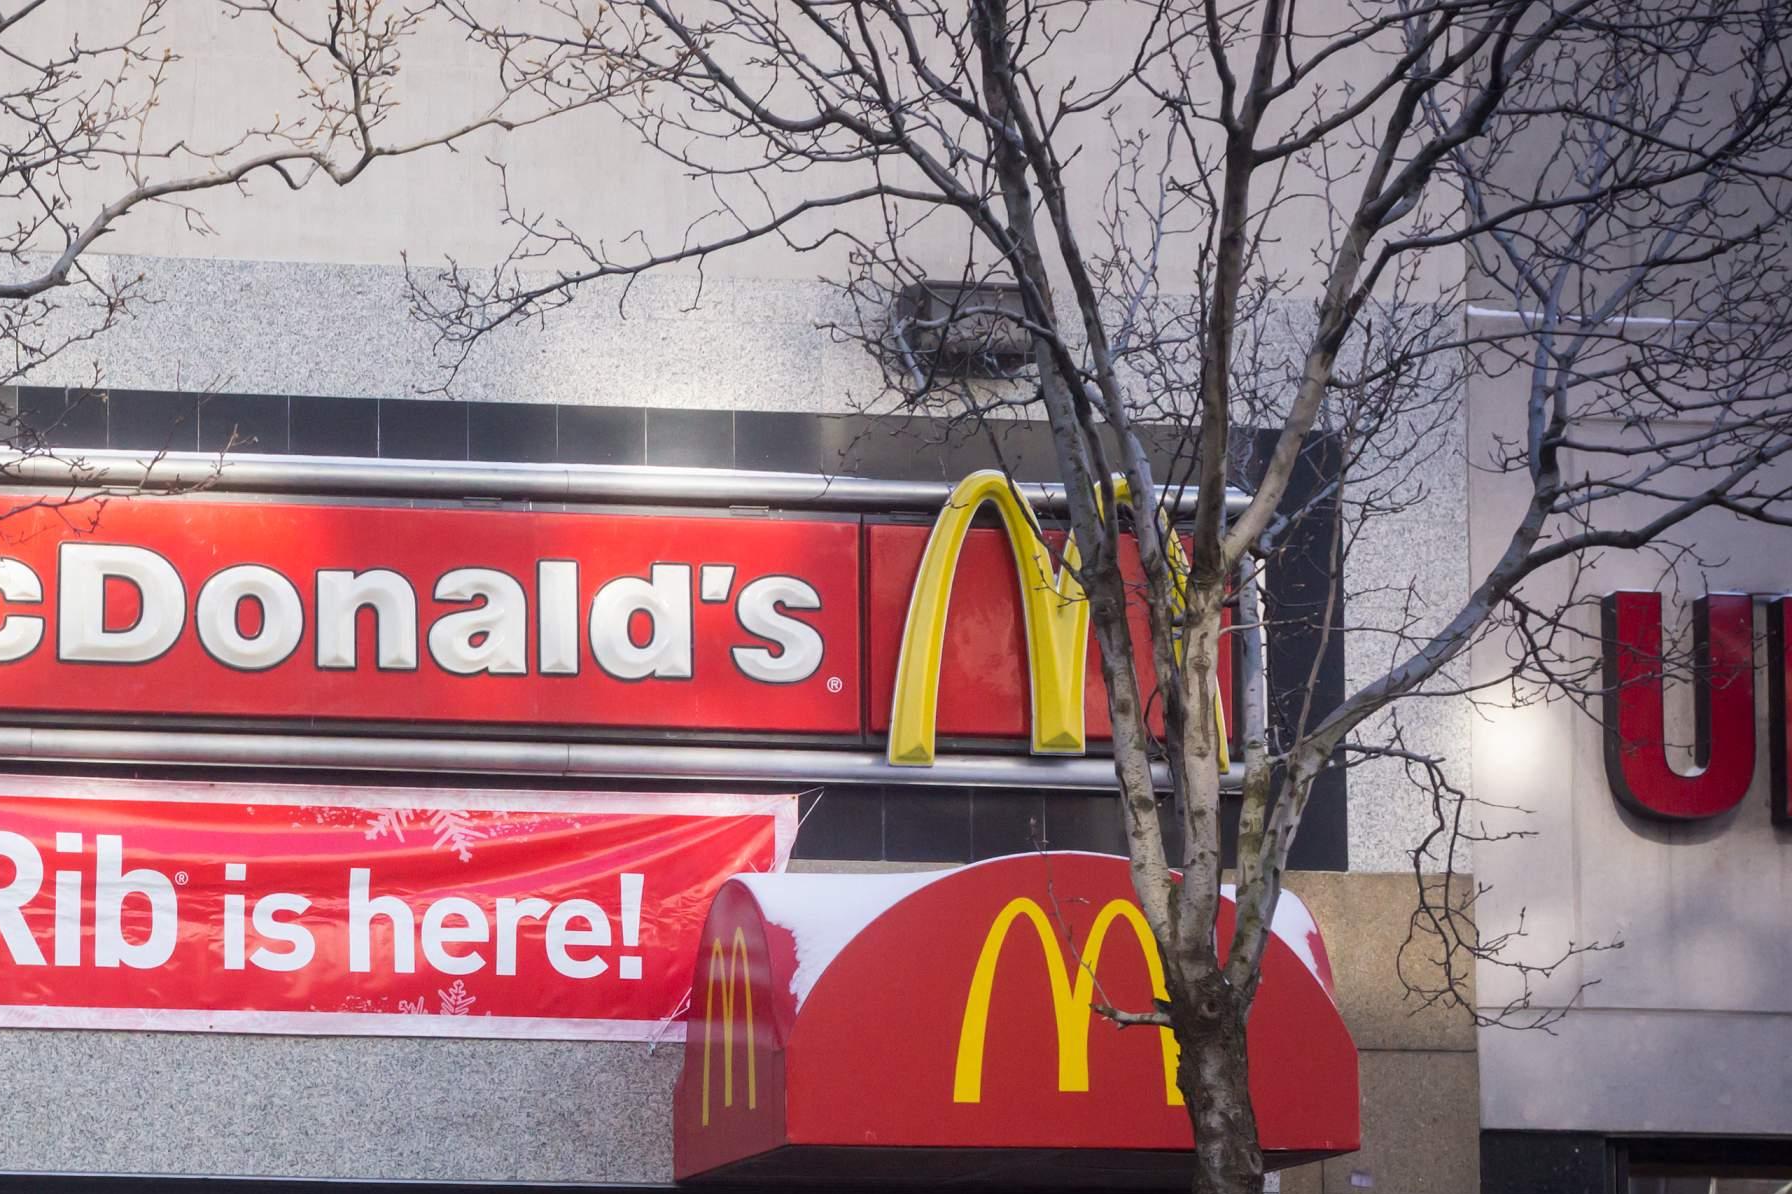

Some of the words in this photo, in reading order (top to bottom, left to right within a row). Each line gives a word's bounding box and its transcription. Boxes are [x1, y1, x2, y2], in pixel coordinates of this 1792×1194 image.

[1602, 590, 1792, 824] U
[223, 863, 316, 973] is
[348, 867, 645, 980] here!
